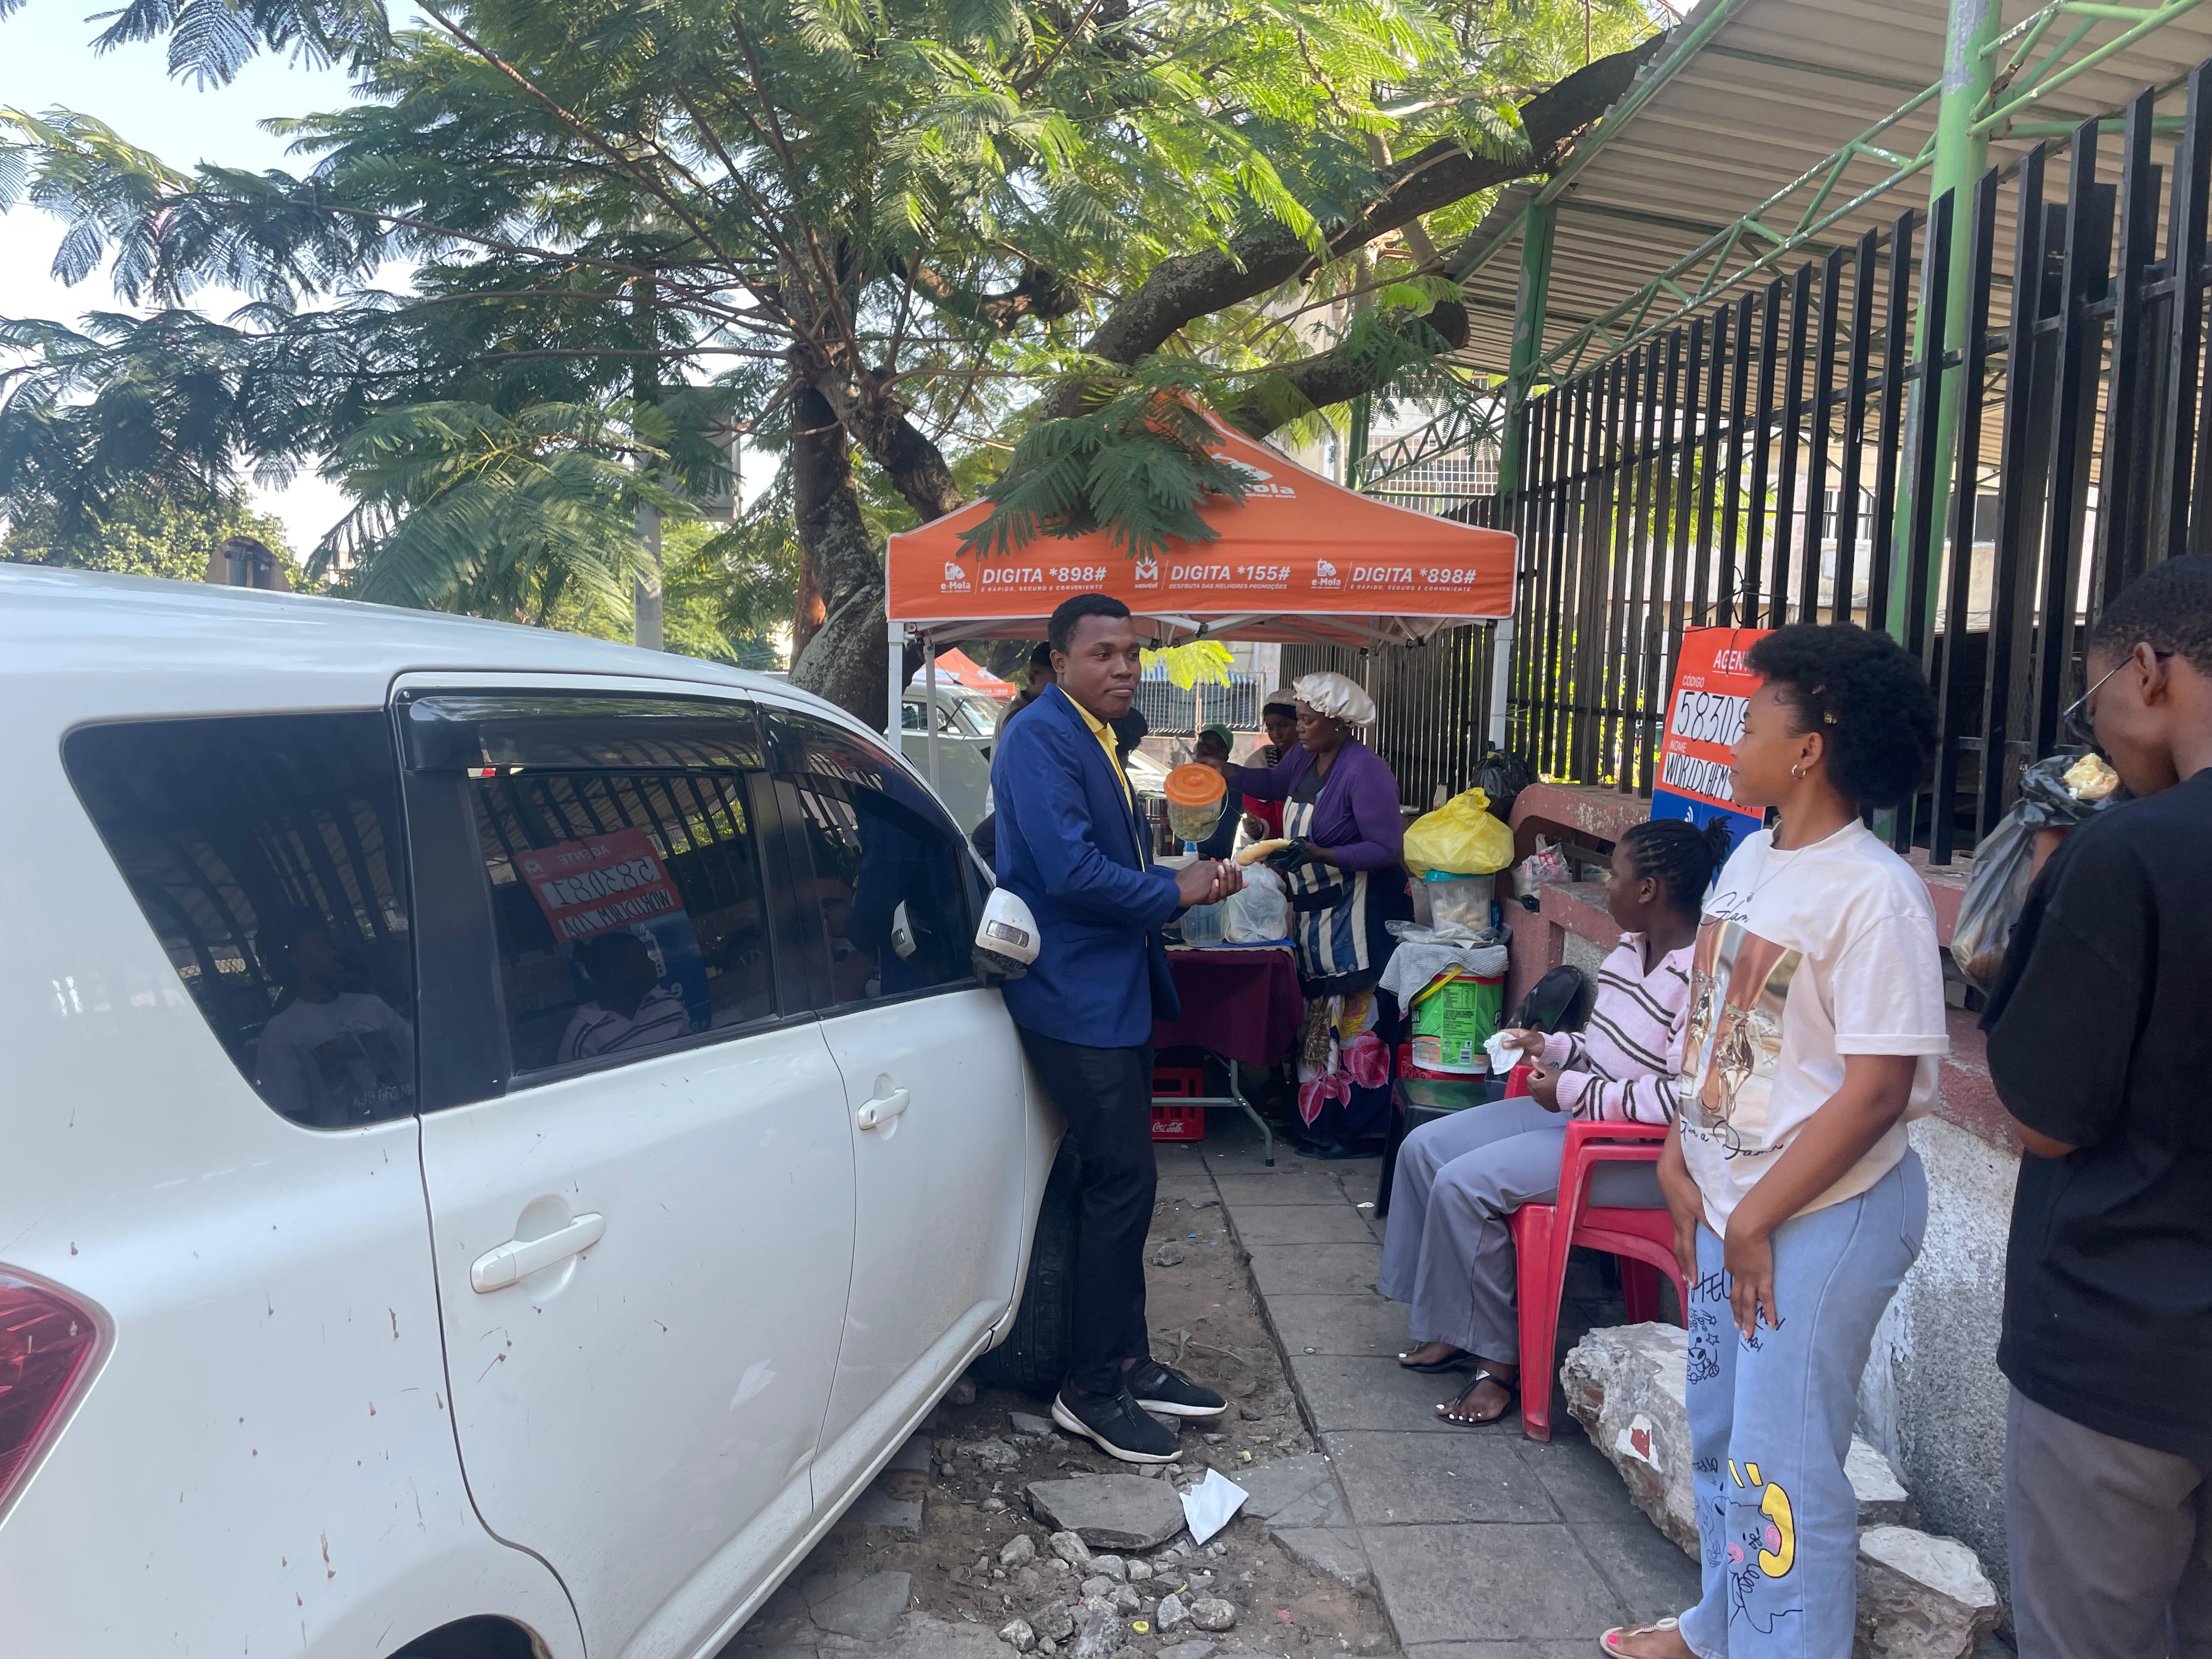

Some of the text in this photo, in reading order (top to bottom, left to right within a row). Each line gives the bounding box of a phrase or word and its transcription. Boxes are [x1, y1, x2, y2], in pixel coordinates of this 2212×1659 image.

[983, 568, 1043, 584] DIGITA
[1171, 565, 1231, 580] DIGITA
[1352, 567, 1412, 583] DIGITA
[941, 581, 971, 590] e-Mola
[1311, 578, 1341, 586] e-Mola
[1713, 650, 1747, 671] AGEN
[1682, 674, 1705, 688] CÓDIGO
[1669, 740, 1688, 753] NOME
